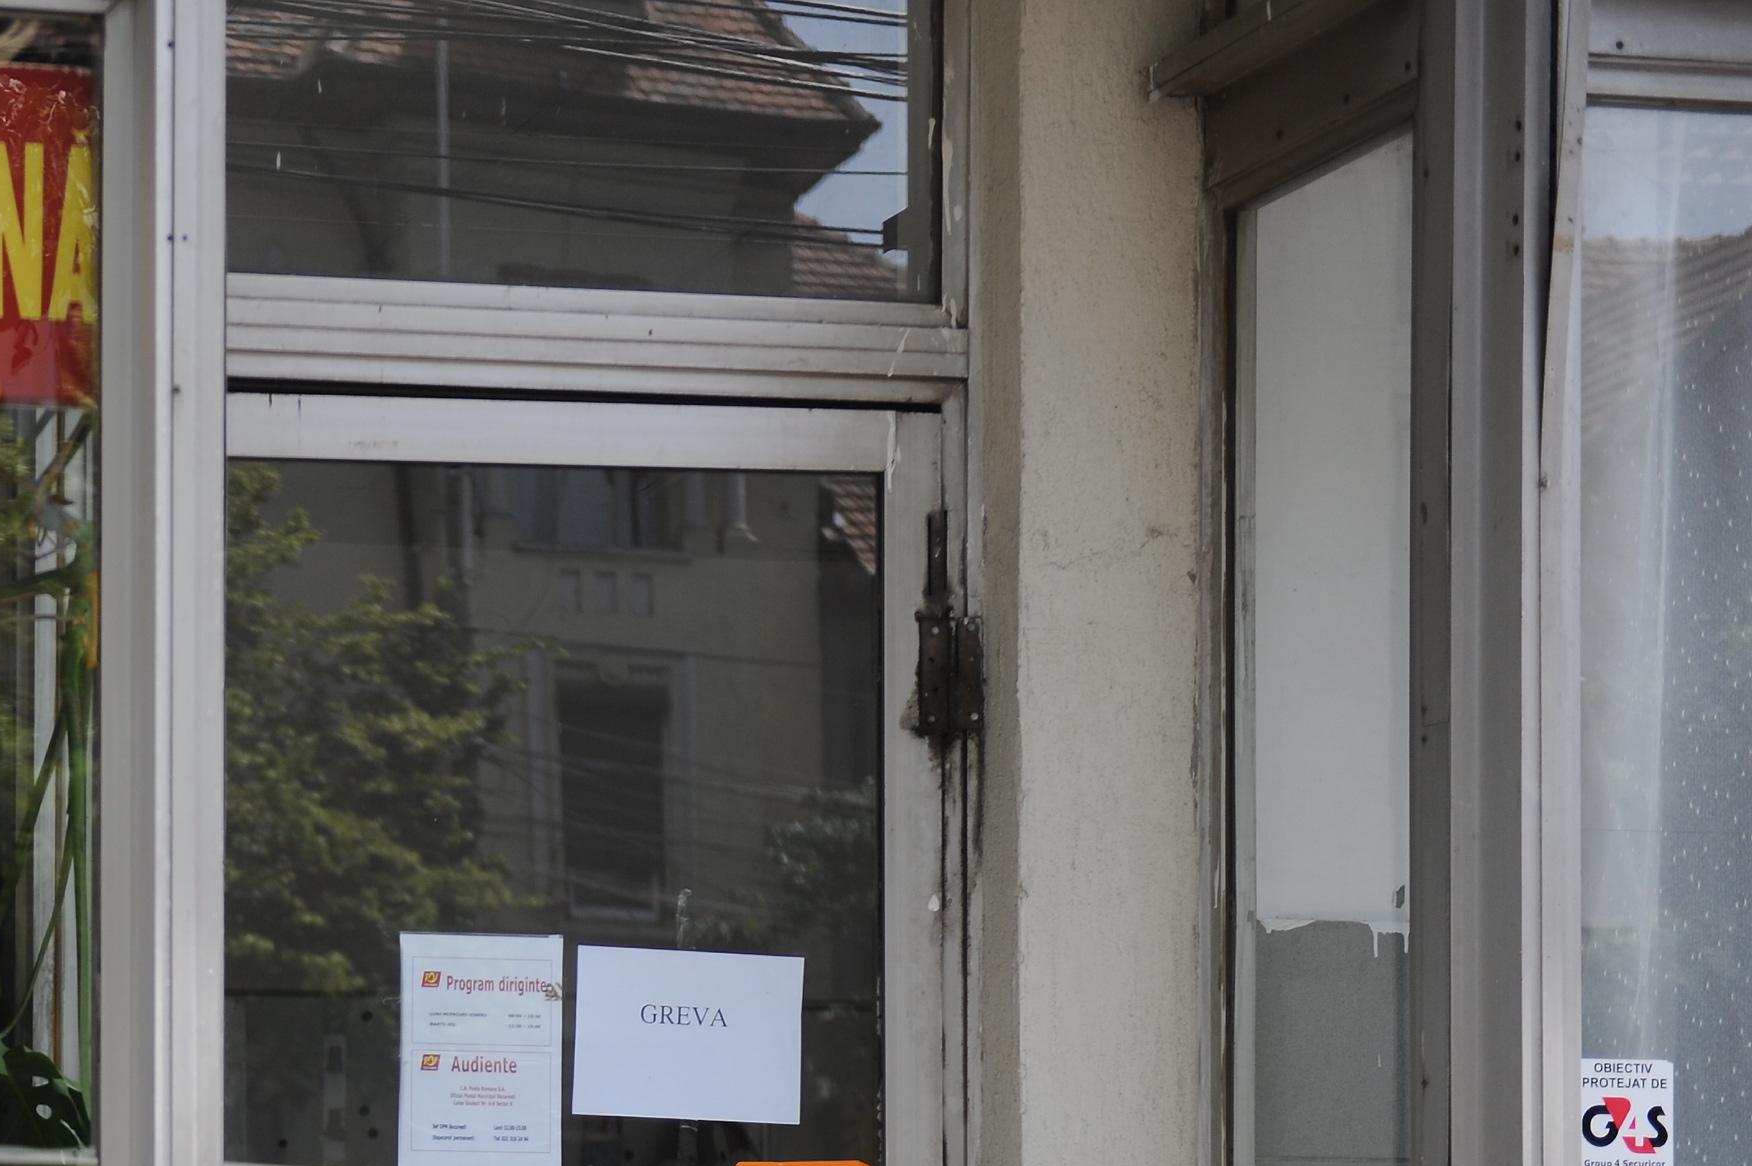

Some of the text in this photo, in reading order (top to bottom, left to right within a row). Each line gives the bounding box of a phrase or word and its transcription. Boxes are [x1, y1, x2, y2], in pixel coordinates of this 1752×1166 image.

[446, 975, 495, 995] Program
[640, 1003, 728, 1027] GREVA
[451, 1055, 518, 1074] Audiente
[1594, 1062, 1653, 1073] OBIECTIV
[1582, 1077, 1668, 1089] PROTEJAT DE
[1582, 1096, 1669, 1154] G4S
